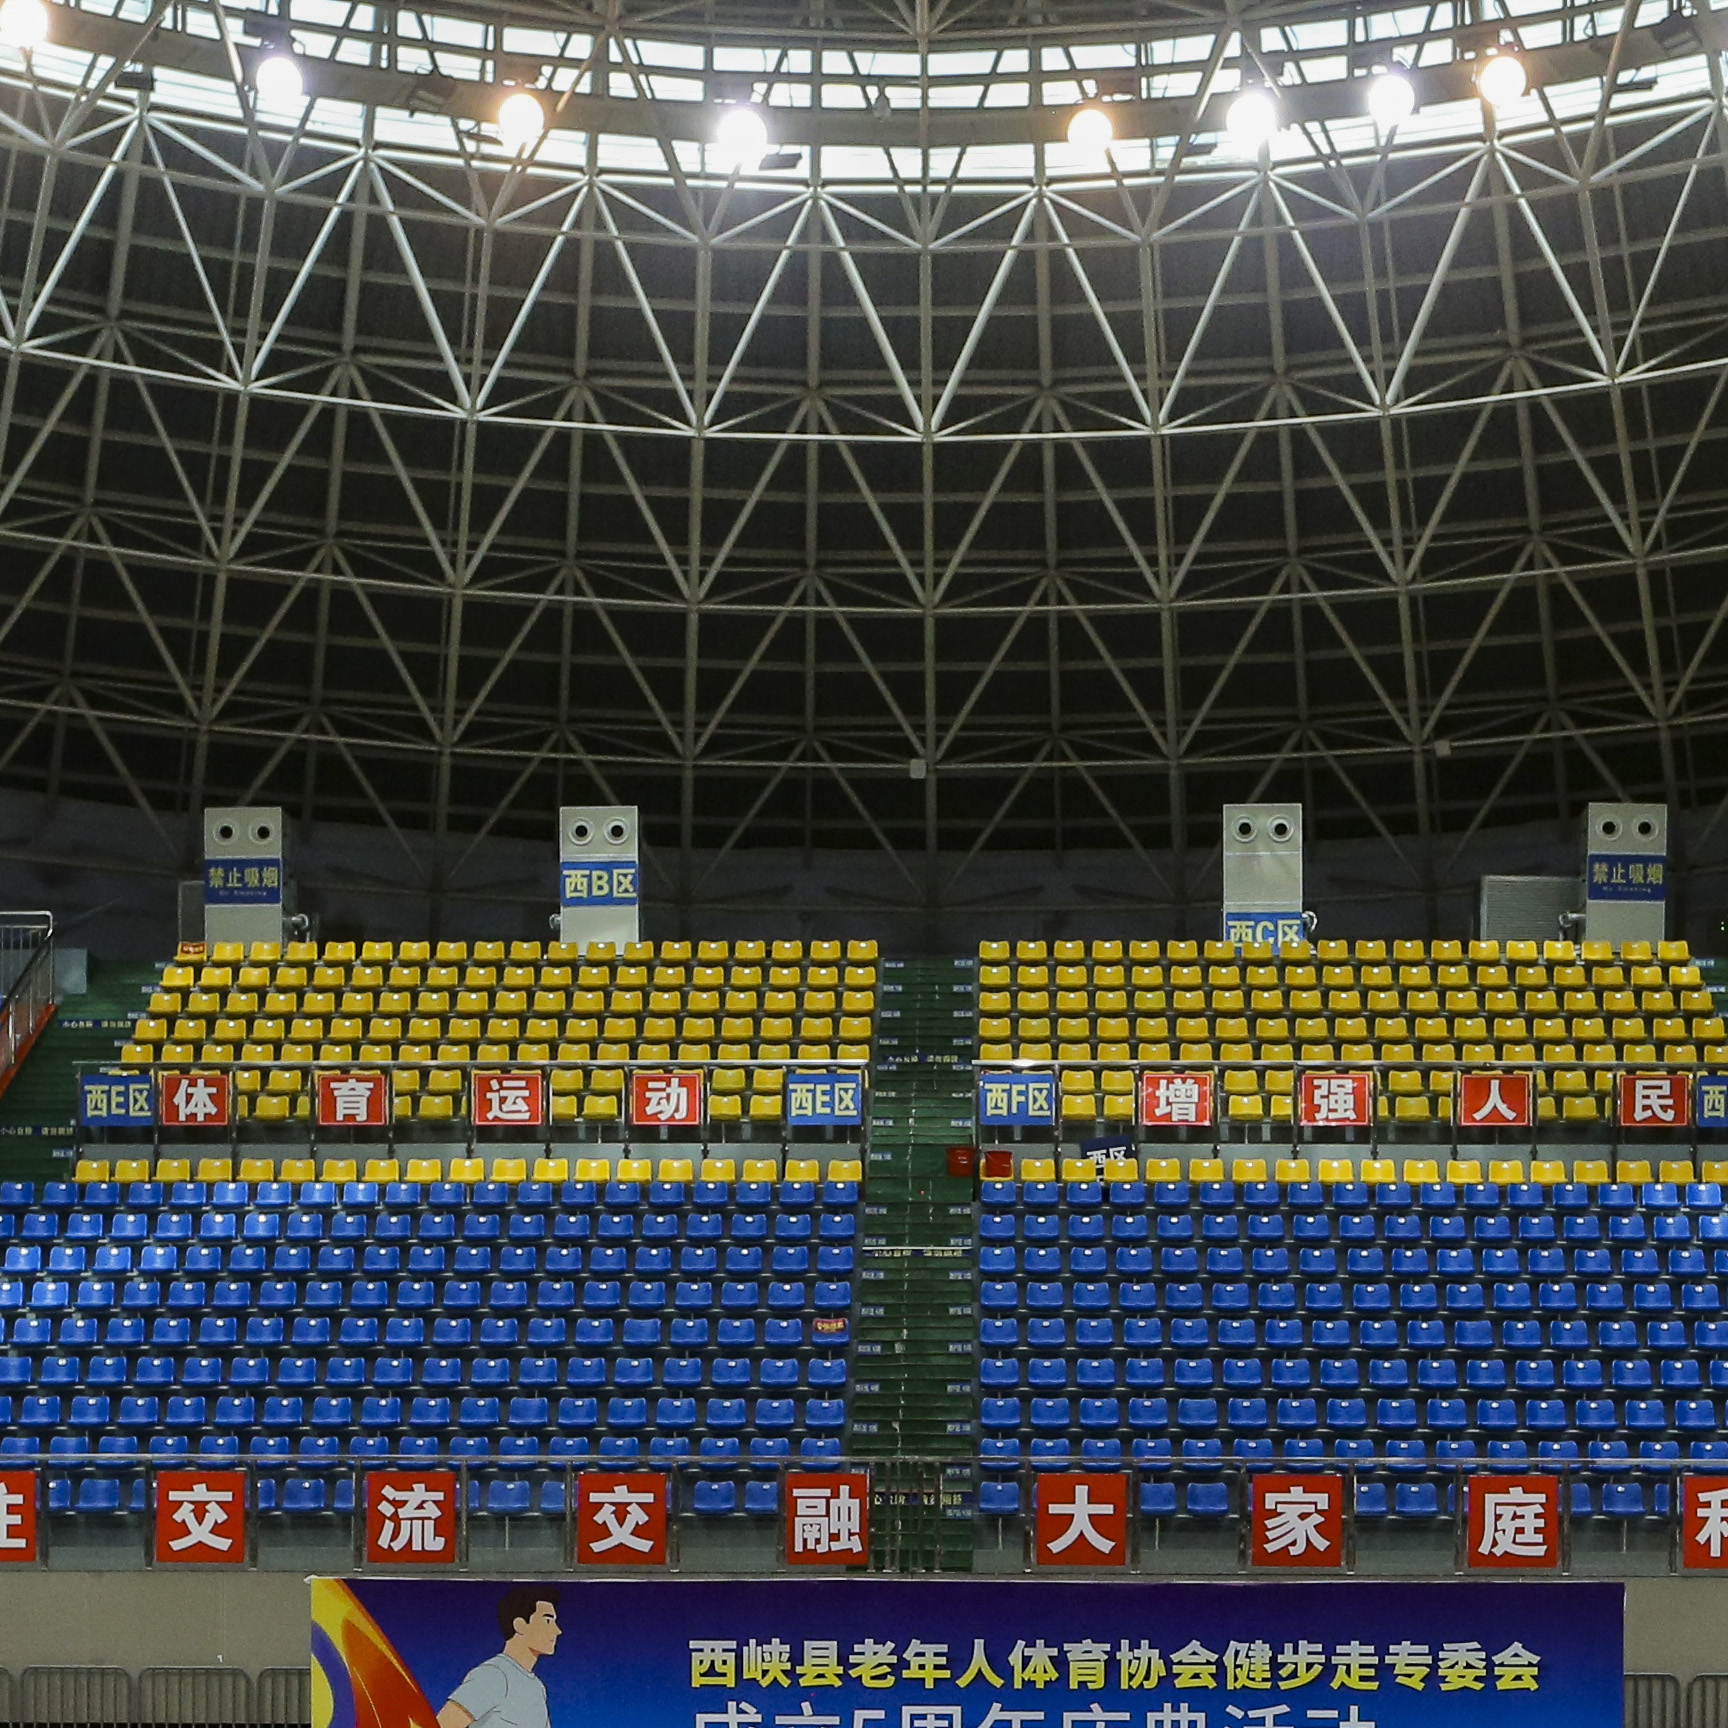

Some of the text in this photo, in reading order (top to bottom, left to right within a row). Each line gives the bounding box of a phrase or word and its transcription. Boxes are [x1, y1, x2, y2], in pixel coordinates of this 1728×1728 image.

[208, 866, 278, 888] 禁止吸烟
[562, 868, 637, 899] 西B区
[1593, 862, 1663, 884] 禁止吸烟
[1227, 919, 1301, 947] 西C区
[84, 1083, 152, 1118] 西E区
[173, 1077, 689, 1123] 体 育 运 动
[789, 1082, 857, 1117] 西E区
[984, 1082, 1051, 1117] 西F区
[1154, 1078, 1676, 1123] 增 强 人 民
[169, 1484, 232, 1550] 交
[378, 1484, 444, 1551] 流
[590, 1485, 654, 1552] 交
[793, 1485, 862, 1552] 融
[1047, 1485, 1115, 1553] 大
[1264, 1487, 1330, 1555] 家
[1478, 1487, 1547, 1556] 庭
[688, 1638, 1542, 1691] 西峡县老年人体育协会健步走专委会
